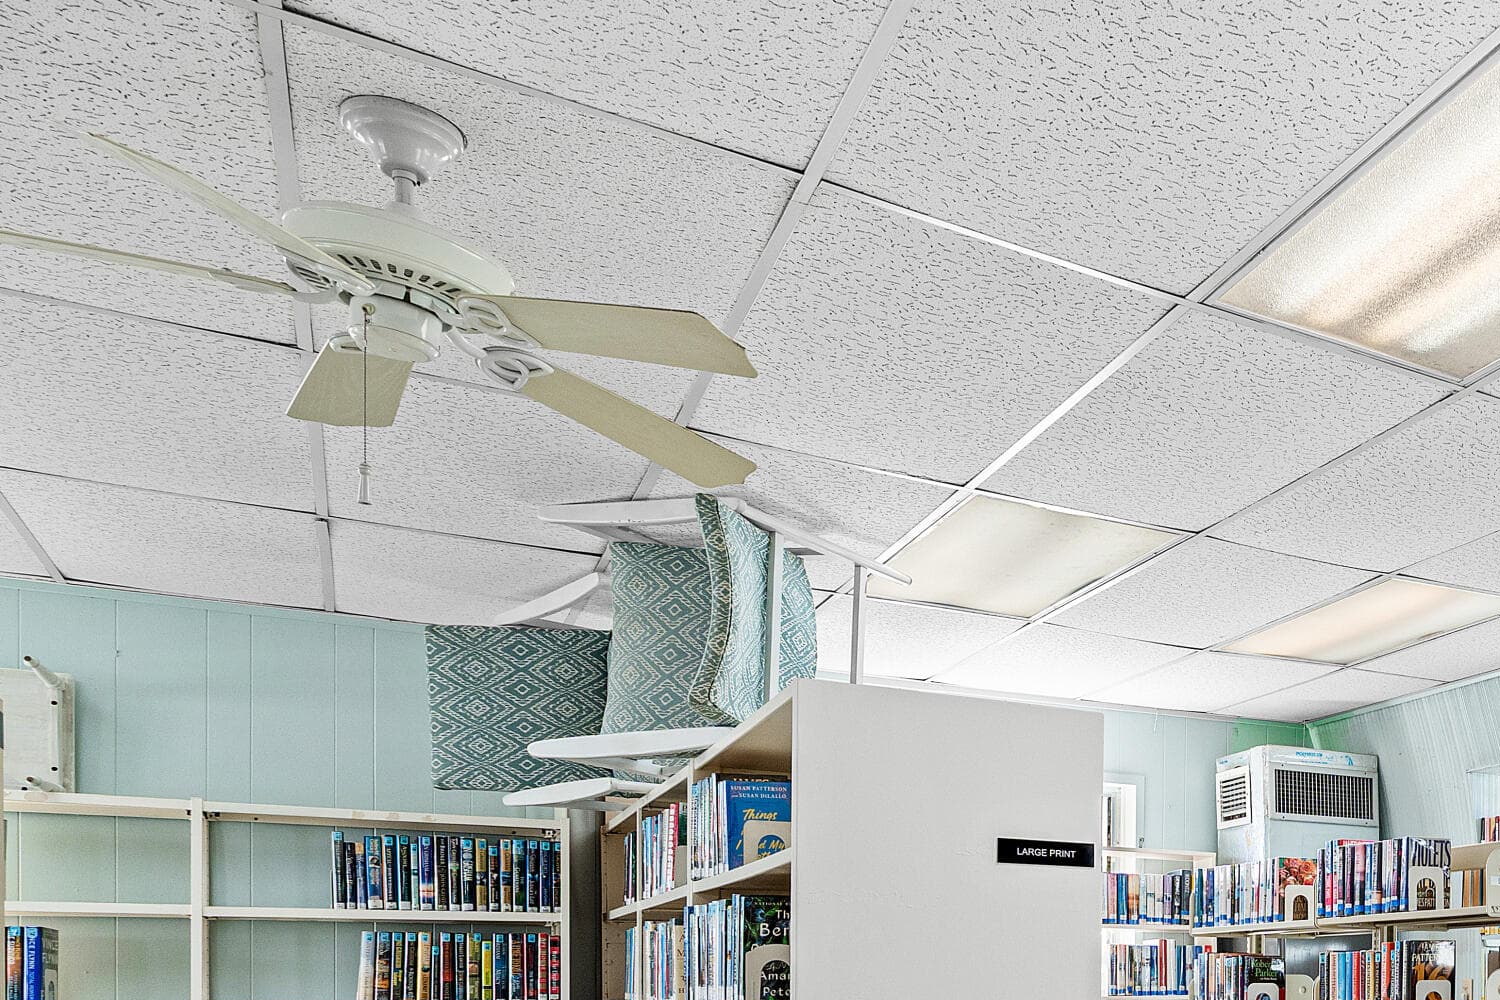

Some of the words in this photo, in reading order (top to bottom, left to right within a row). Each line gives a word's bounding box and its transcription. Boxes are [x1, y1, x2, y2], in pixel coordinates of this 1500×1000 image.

[742, 808, 777, 820] Things
[1017, 848, 1047, 857] LARGE
[1049, 849, 1076, 858] PRINT
